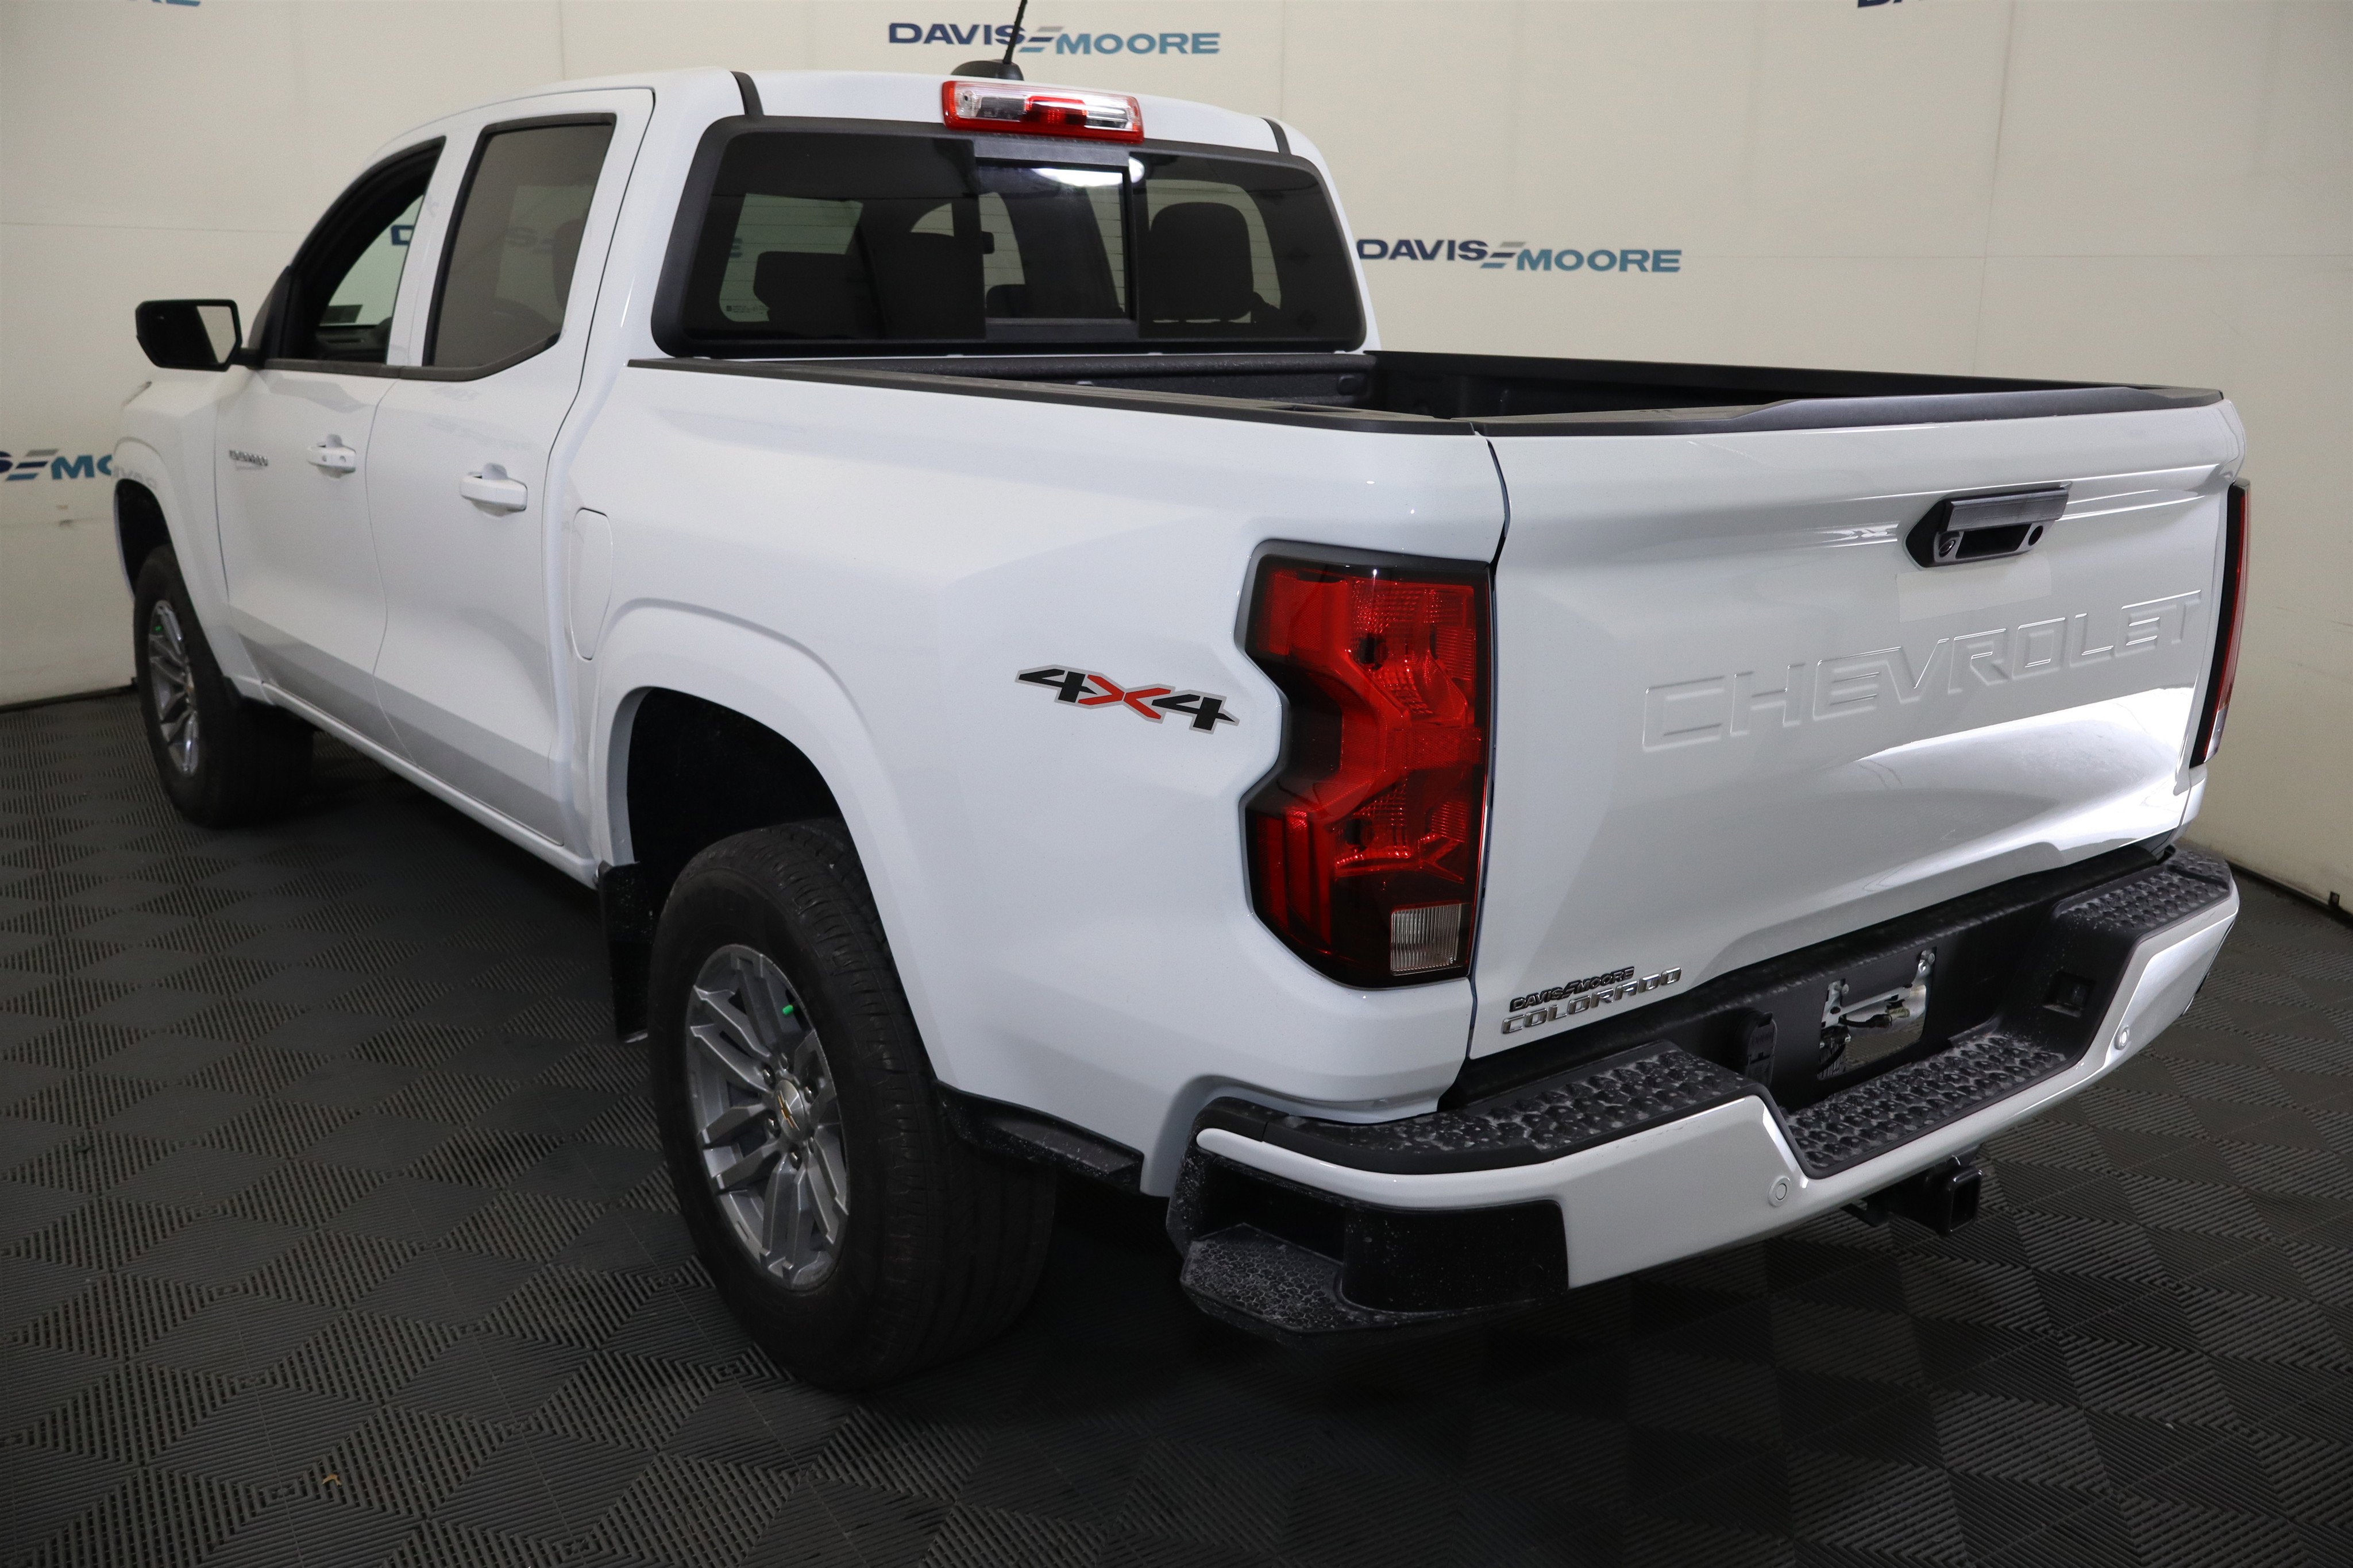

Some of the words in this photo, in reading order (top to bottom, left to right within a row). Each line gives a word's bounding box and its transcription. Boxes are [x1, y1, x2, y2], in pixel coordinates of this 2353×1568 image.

[889, 22, 1025, 45] DAVIS
[1056, 32, 1221, 55] MOORE
[1356, 238, 1488, 261] DAVIS
[1516, 249, 1683, 273] MOORE
[1641, 590, 2201, 753] CHEVROLET
[1500, 966, 1682, 1034] COLORADO
